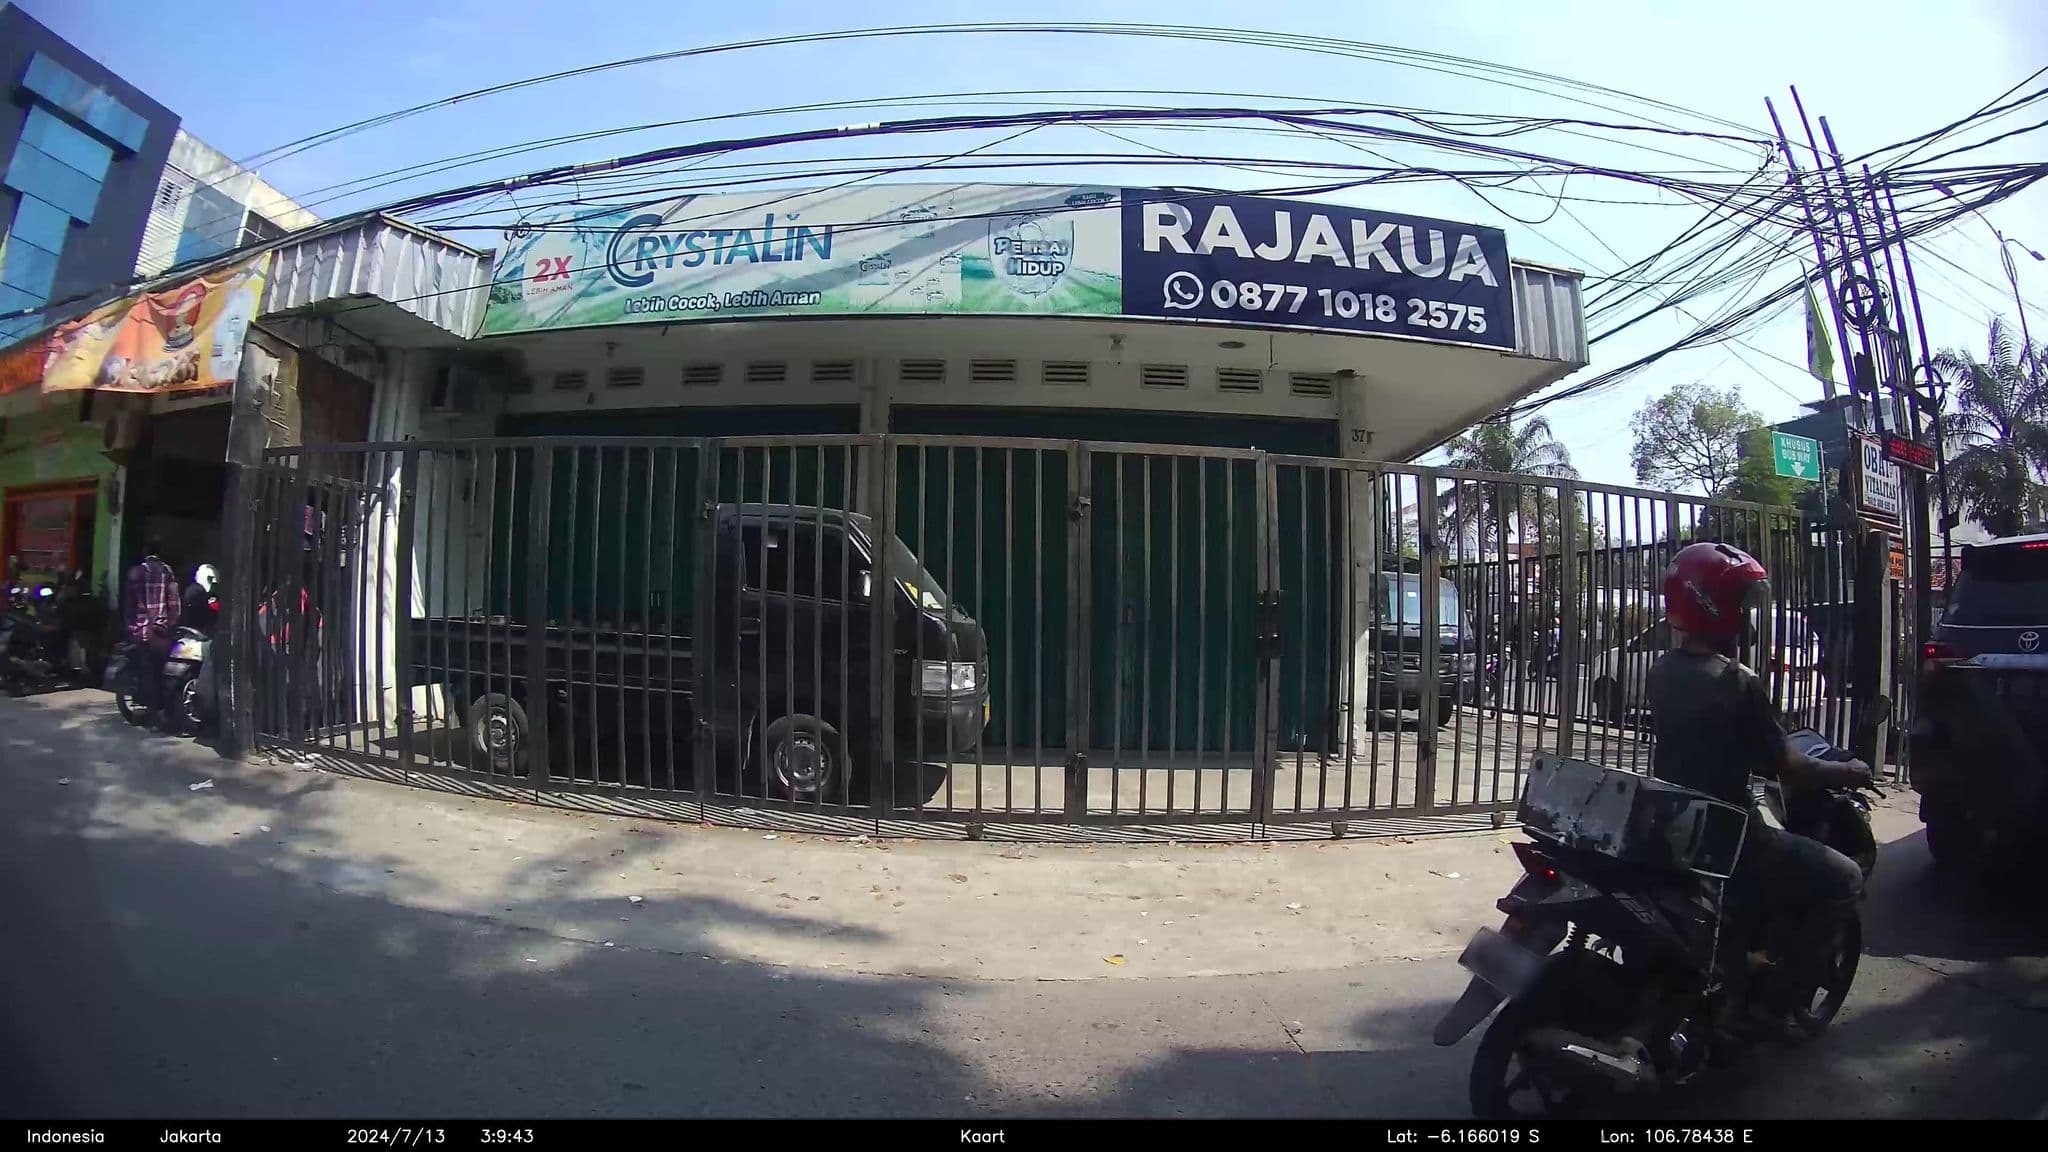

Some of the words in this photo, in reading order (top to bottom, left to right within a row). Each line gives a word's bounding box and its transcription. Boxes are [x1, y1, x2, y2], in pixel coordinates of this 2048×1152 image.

[994, 237, 1069, 257] PEAI
[1142, 200, 1499, 288] RAJAKUA
[532, 256, 573, 282] 2X
[1007, 257, 1065, 276] HIDUP
[624, 297, 665, 314] Lebih
[667, 294, 721, 312] Cocok,
[724, 291, 770, 309] Lebih
[771, 290, 822, 307] Aman
[1210, 280, 1308, 314] 0877
[1317, 288, 1398, 323] 1018
[1406, 298, 1488, 335] 2575
[1780, 437, 1810, 452] KHUSUS
